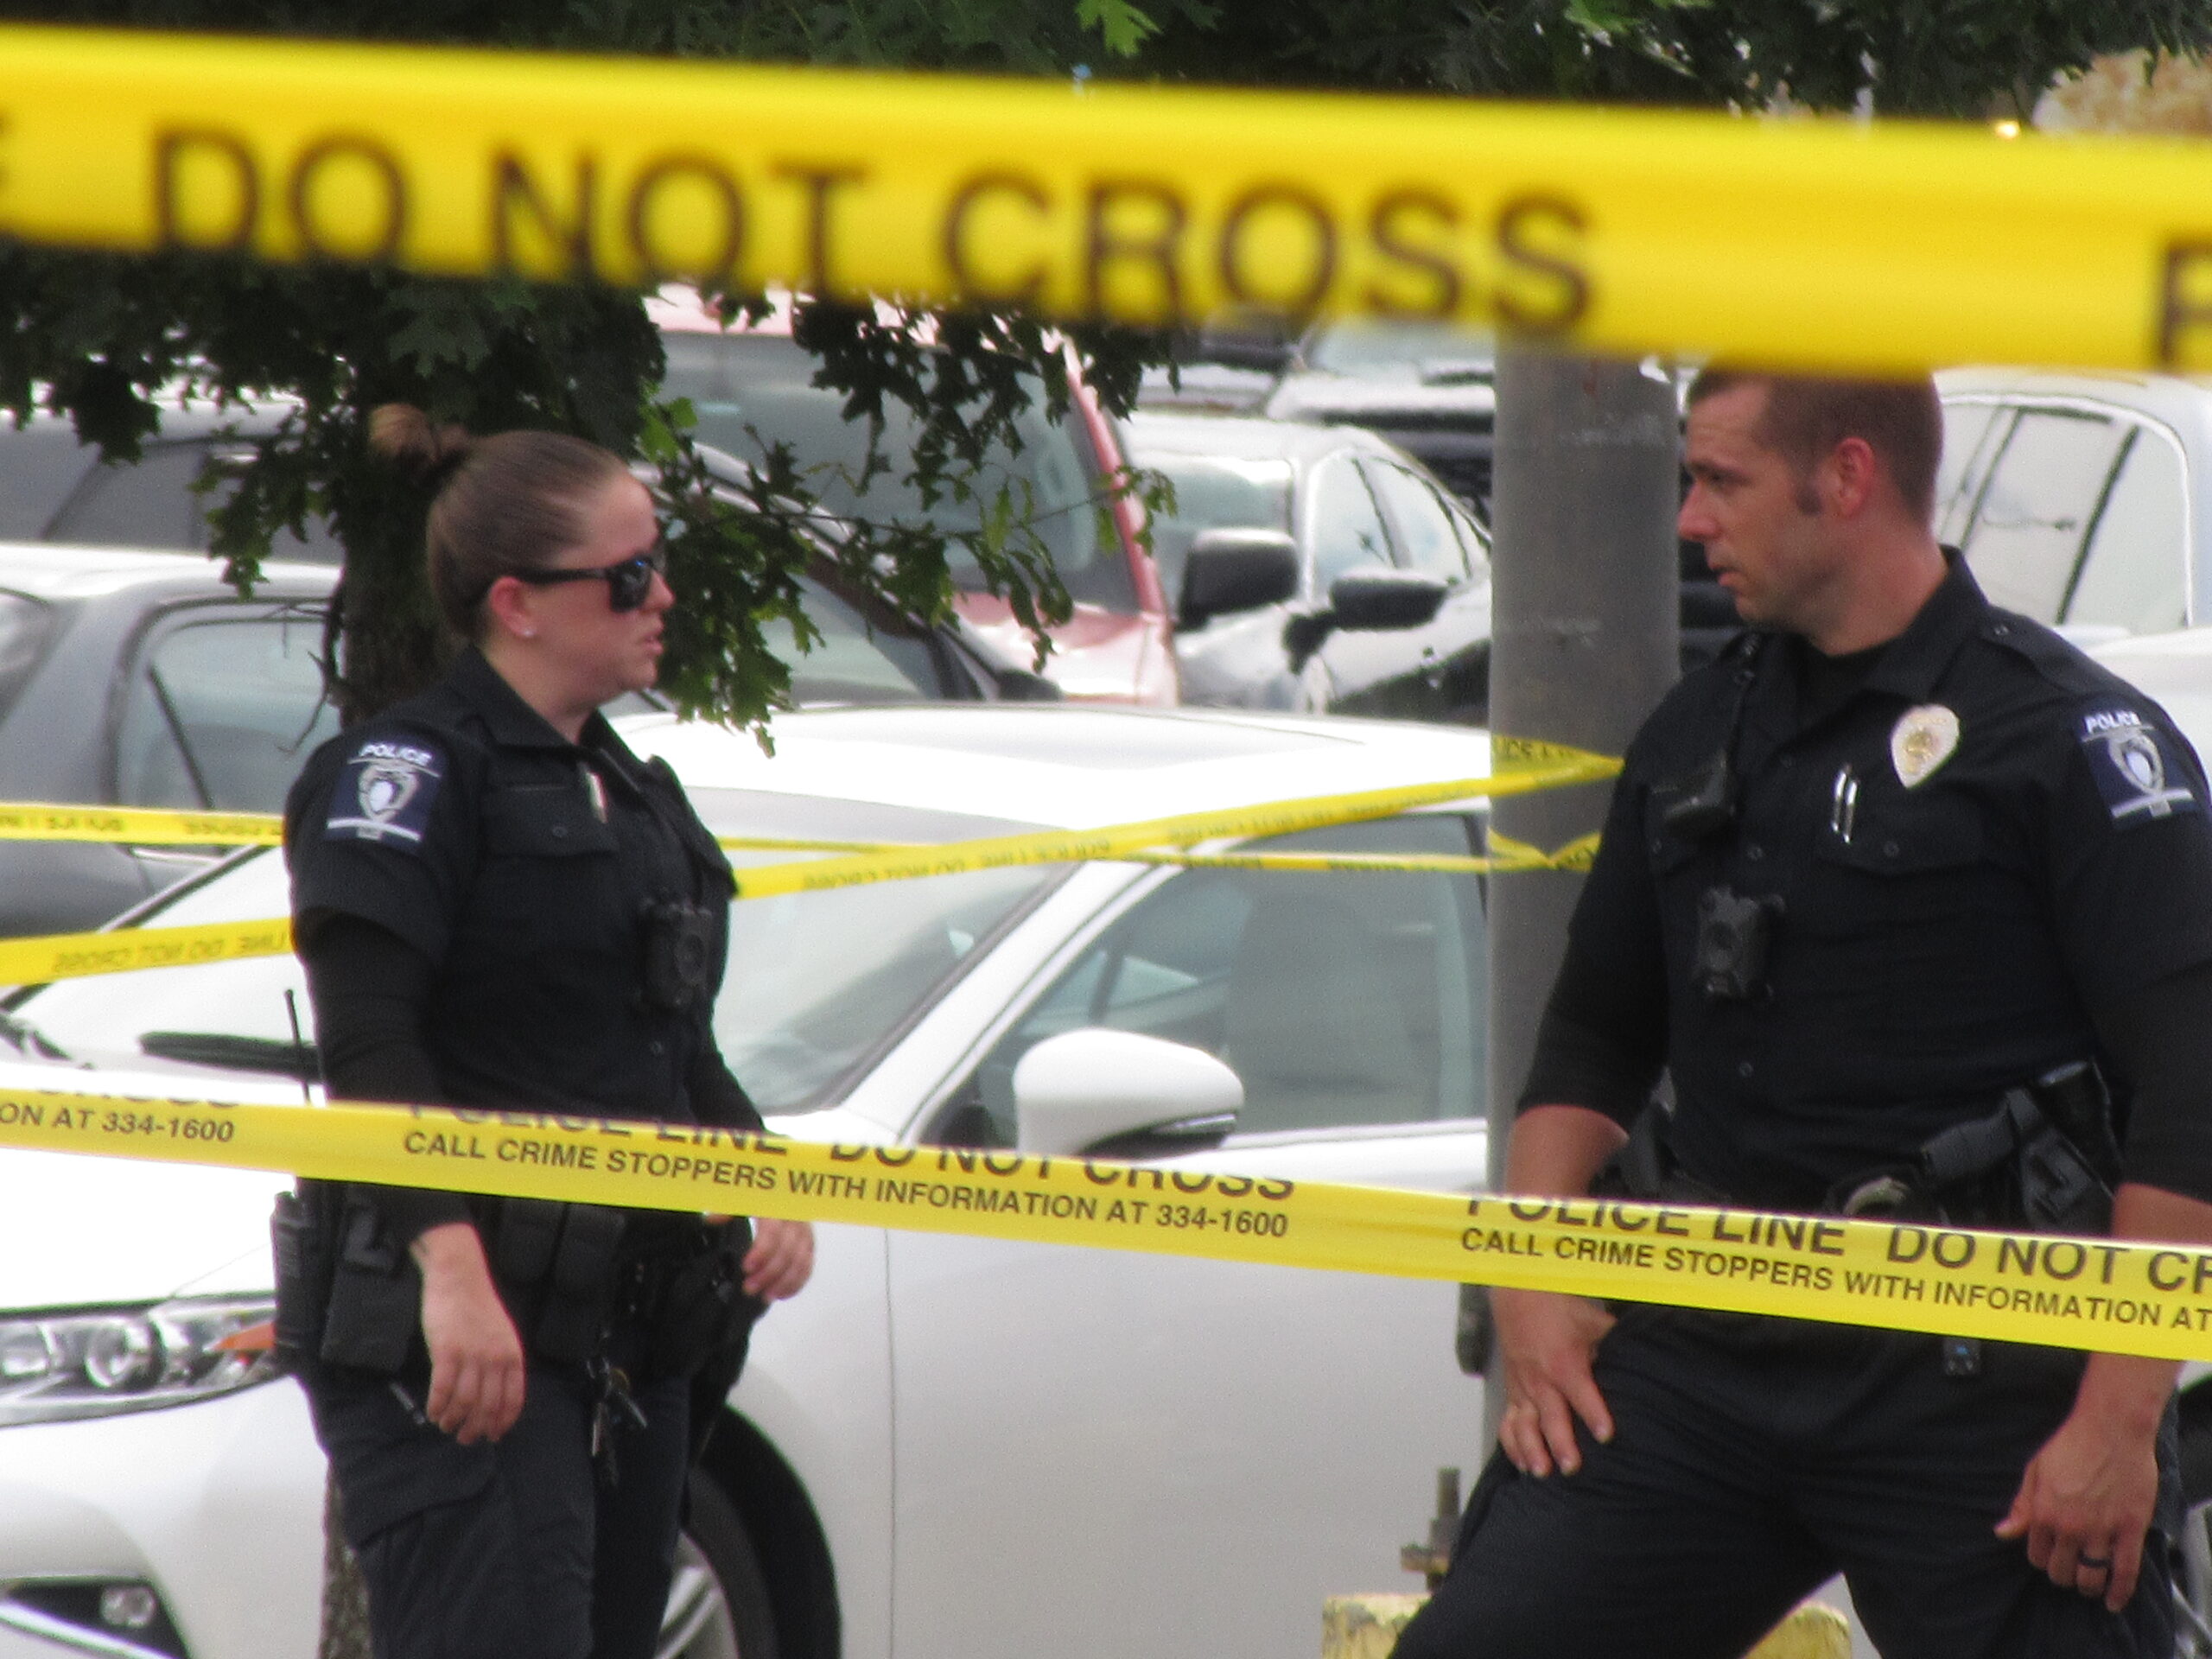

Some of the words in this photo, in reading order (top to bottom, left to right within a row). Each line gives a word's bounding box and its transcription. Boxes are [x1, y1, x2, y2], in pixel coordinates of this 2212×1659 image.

[147, 117, 408, 263] DO
[488, 143, 873, 298] NOT
[938, 164, 1599, 335] CROSS
[359, 743, 433, 766] POLICE
[52, 1106, 95, 1131] AT
[101, 1111, 235, 1143] 334-1600
[404, 1131, 486, 1160] CALL
[497, 1138, 599, 1170] CRIME
[606, 1148, 779, 1190] STOPPERS
[788, 1169, 868, 1200] WITH
[875, 1178, 1097, 1222] INFORMATION
[1106, 1199, 1149, 1225] AT
[1156, 1204, 1289, 1238] 334-1600
[1461, 1227, 1544, 1257] CALL
[1554, 1236, 1656, 1269] CRIME
[1664, 1247, 1834, 1292] STOPPERS
[1844, 1270, 1926, 1302] WITH
[1934, 1281, 2162, 1326] INFORMATION
[2170, 1306, 2212, 1332] AT
[1713, 1211, 1847, 1256] LINE
[1886, 1224, 1977, 1269] DO
[1996, 1237, 2130, 1285] NOT
